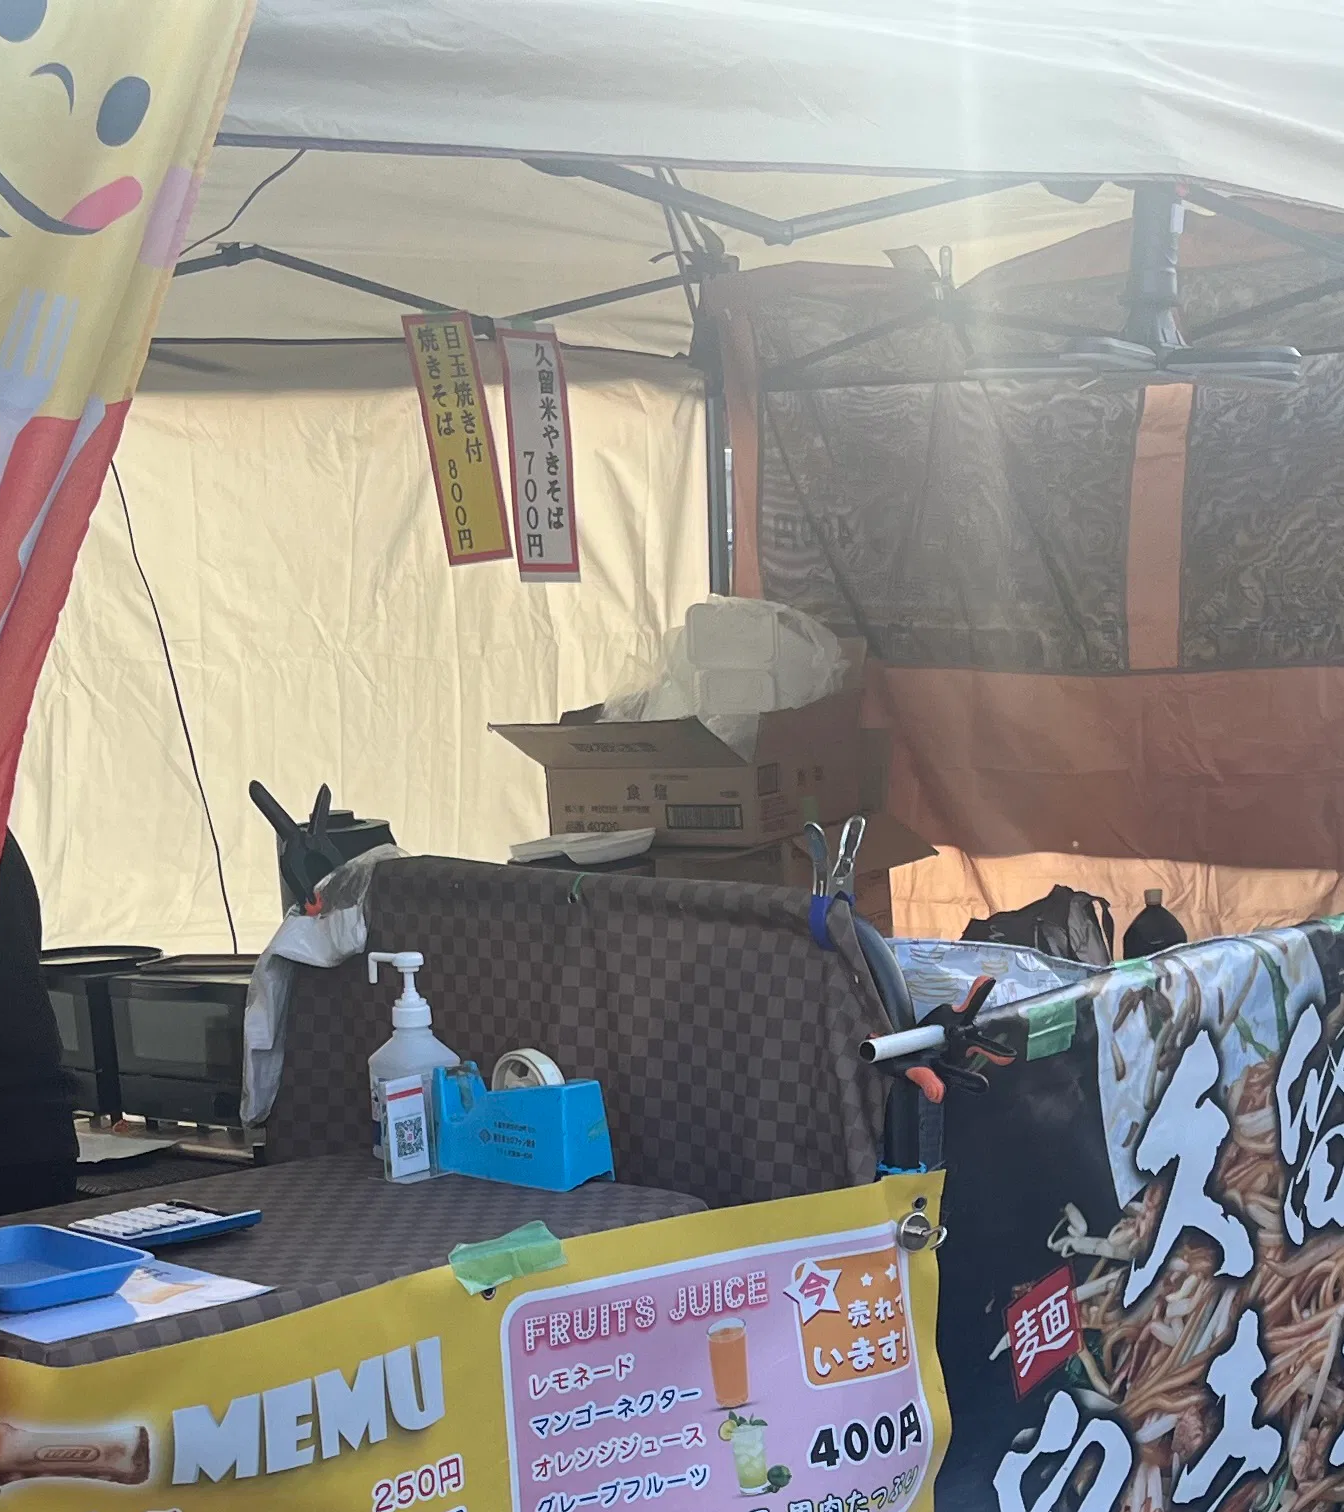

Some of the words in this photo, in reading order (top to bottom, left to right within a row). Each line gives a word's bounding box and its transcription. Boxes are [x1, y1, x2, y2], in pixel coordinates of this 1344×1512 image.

[444, 325, 483, 464] 目玉焼き付
[417, 327, 456, 437] 焼きそば
[448, 458, 474, 550] 800円
[535, 342, 565, 531] 久留米やきそば
[523, 451, 544, 559] 700円
[524, 1296, 656, 1351] FRUITS
[669, 1271, 768, 1321] JUICE
[799, 1272, 830, 1306] 今
[1012, 1286, 1070, 1381] 麺
[172, 1336, 446, 1485] MEMU
[531, 1355, 635, 1397] レモネード
[531, 1390, 701, 1436] マンゴーネクター
[533, 1426, 704, 1479] オレンジジュース
[810, 1404, 924, 1468] 400円
[374, 1458, 463, 1512] 250円
